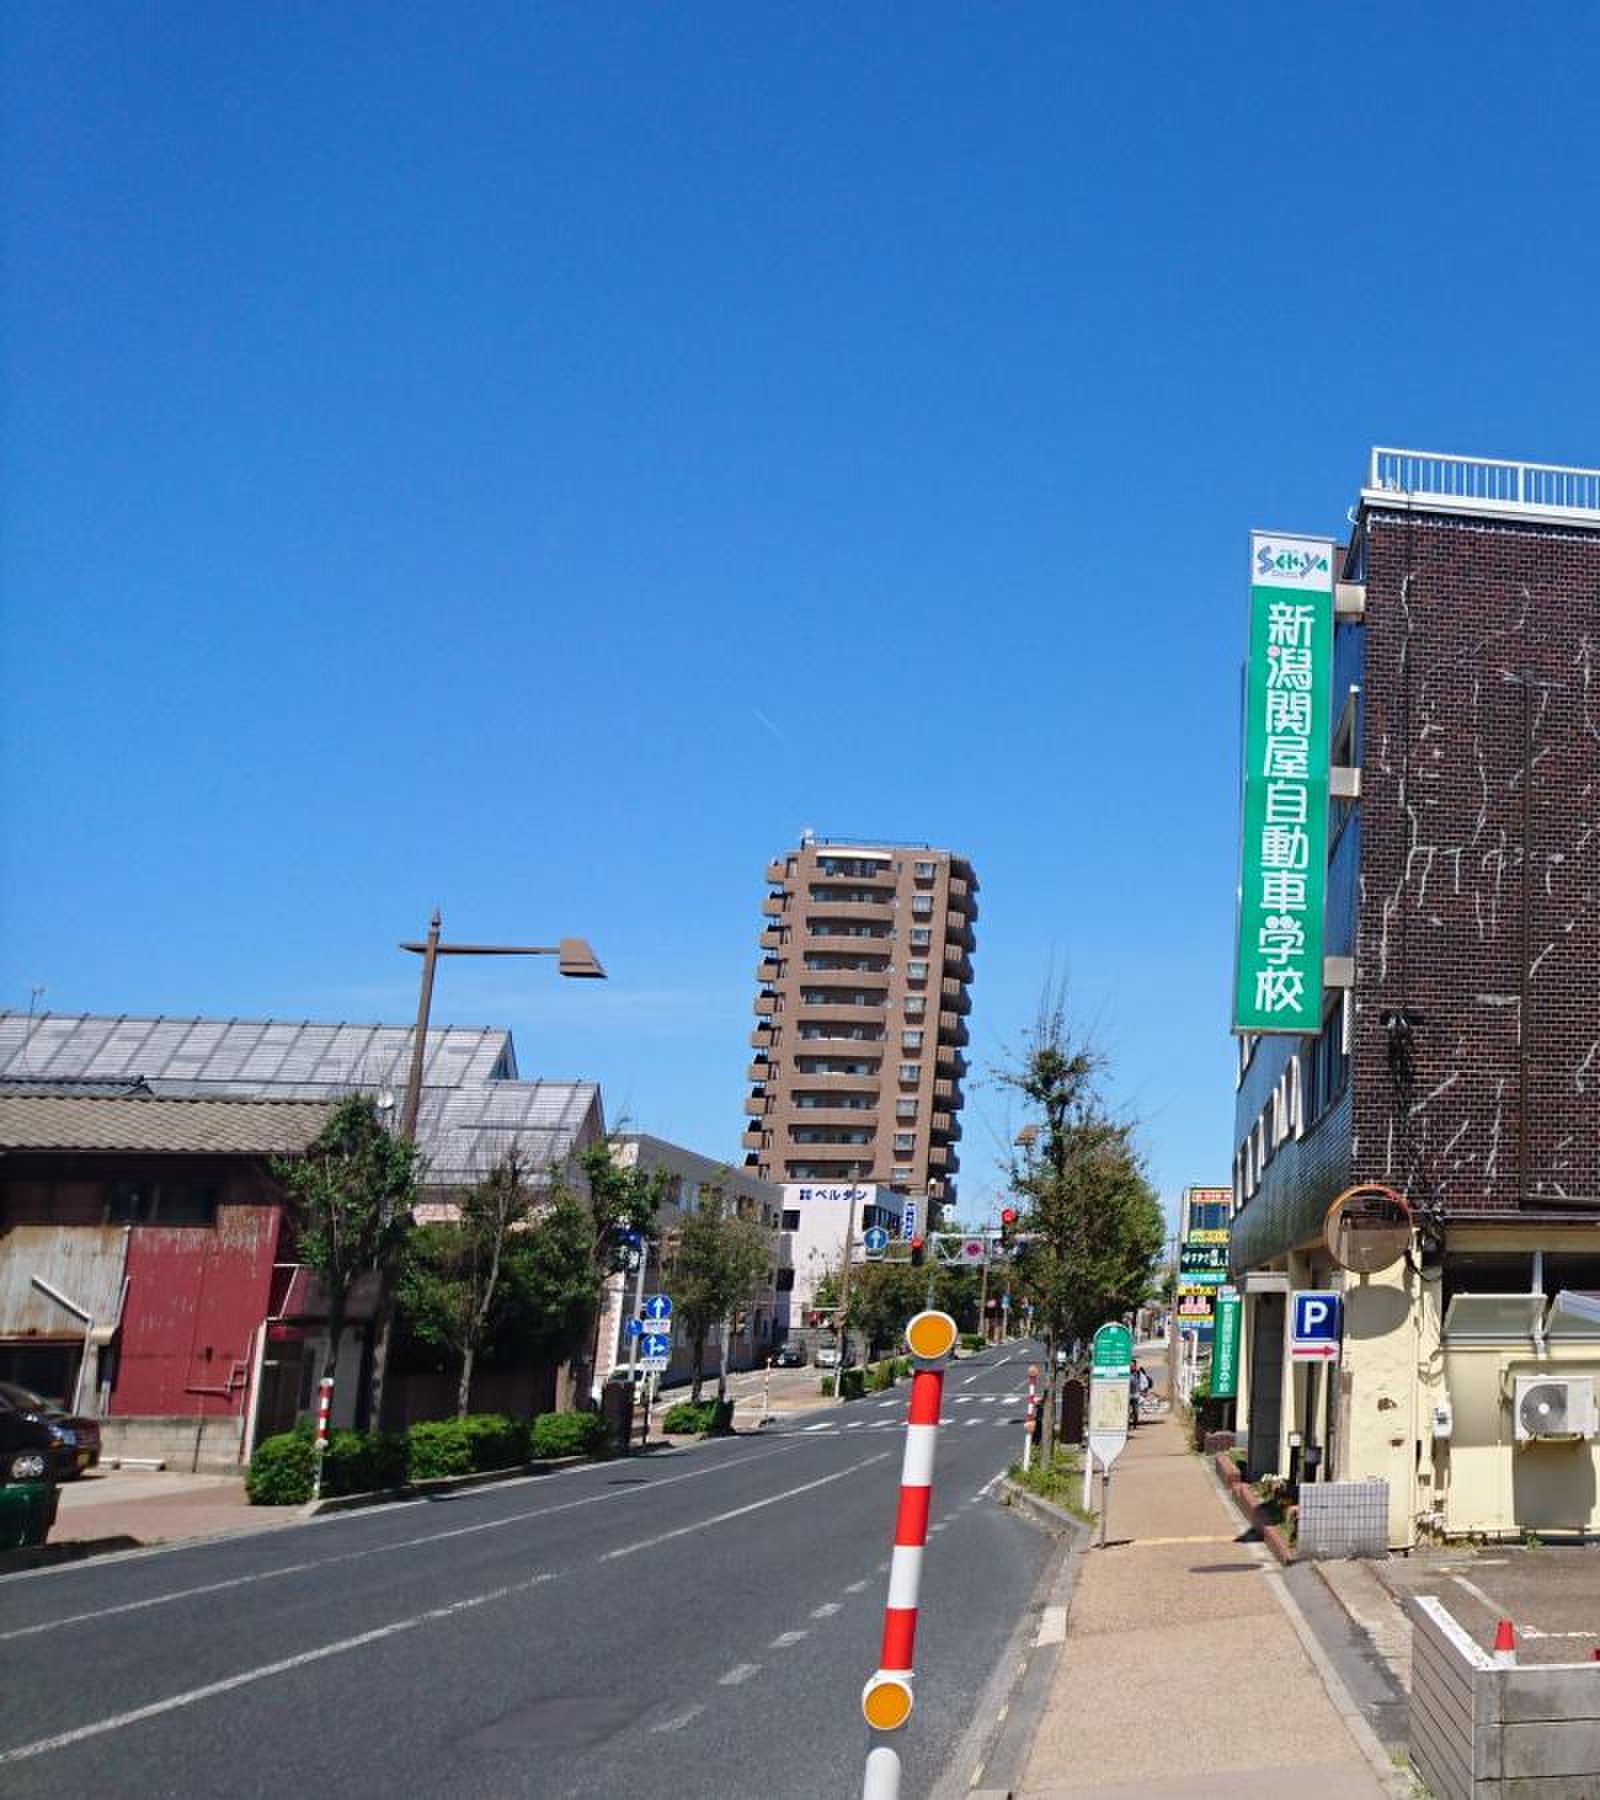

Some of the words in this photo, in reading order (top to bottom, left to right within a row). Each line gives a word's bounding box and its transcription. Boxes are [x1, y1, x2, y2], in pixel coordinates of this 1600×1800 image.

[1254, 601, 1315, 1013] 新潟関屋自動車学校
[1304, 1300, 1328, 1334] P
